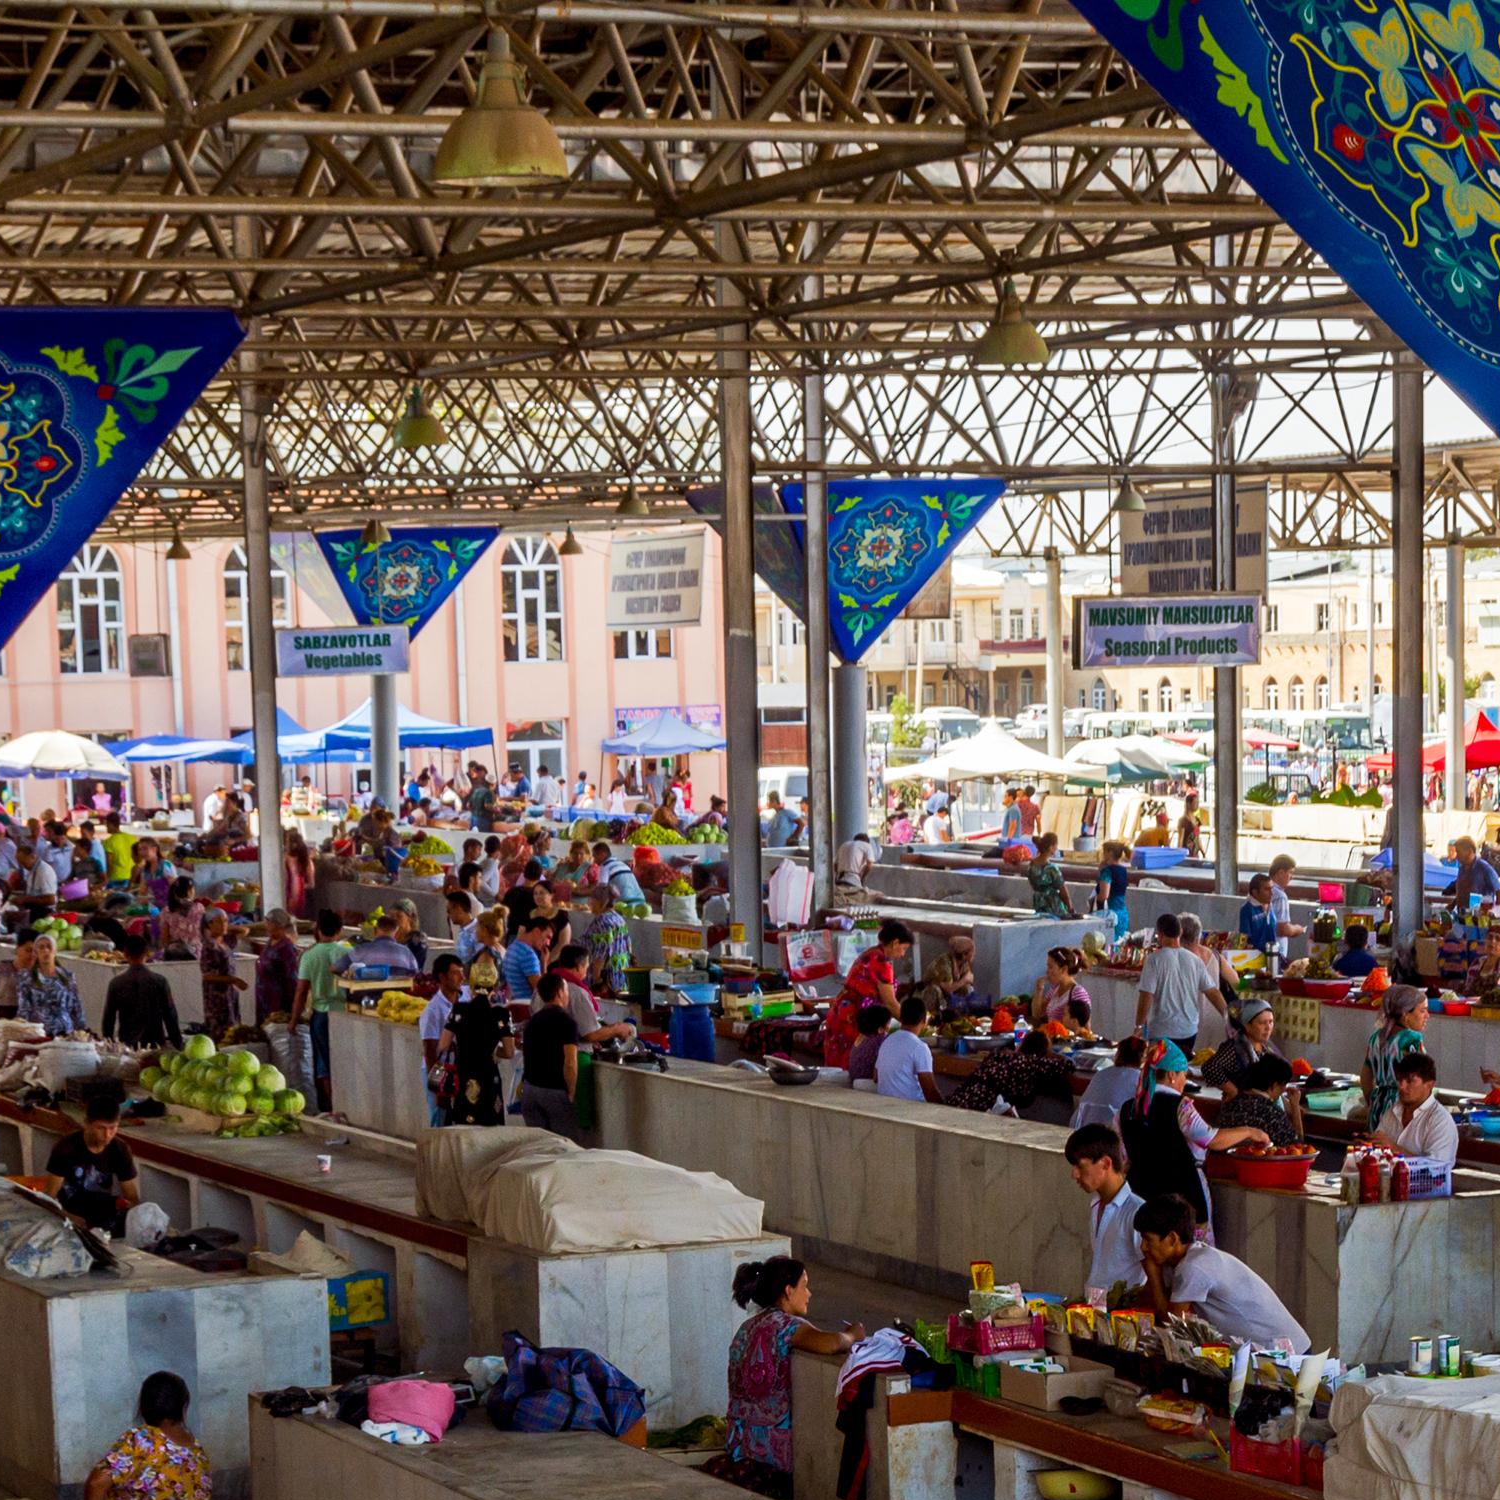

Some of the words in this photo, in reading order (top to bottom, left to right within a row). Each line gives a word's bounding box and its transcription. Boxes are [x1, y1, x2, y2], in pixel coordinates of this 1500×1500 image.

[1089, 606, 1159, 627] MAVSUMIY
[1162, 605, 1254, 625] MAHSULOTLAR
[294, 633, 391, 650] SABZAVOTLAR
[1104, 637, 1171, 657] Seasonal
[1174, 636, 1238, 655] Products
[304, 652, 383, 669] Vegetables
